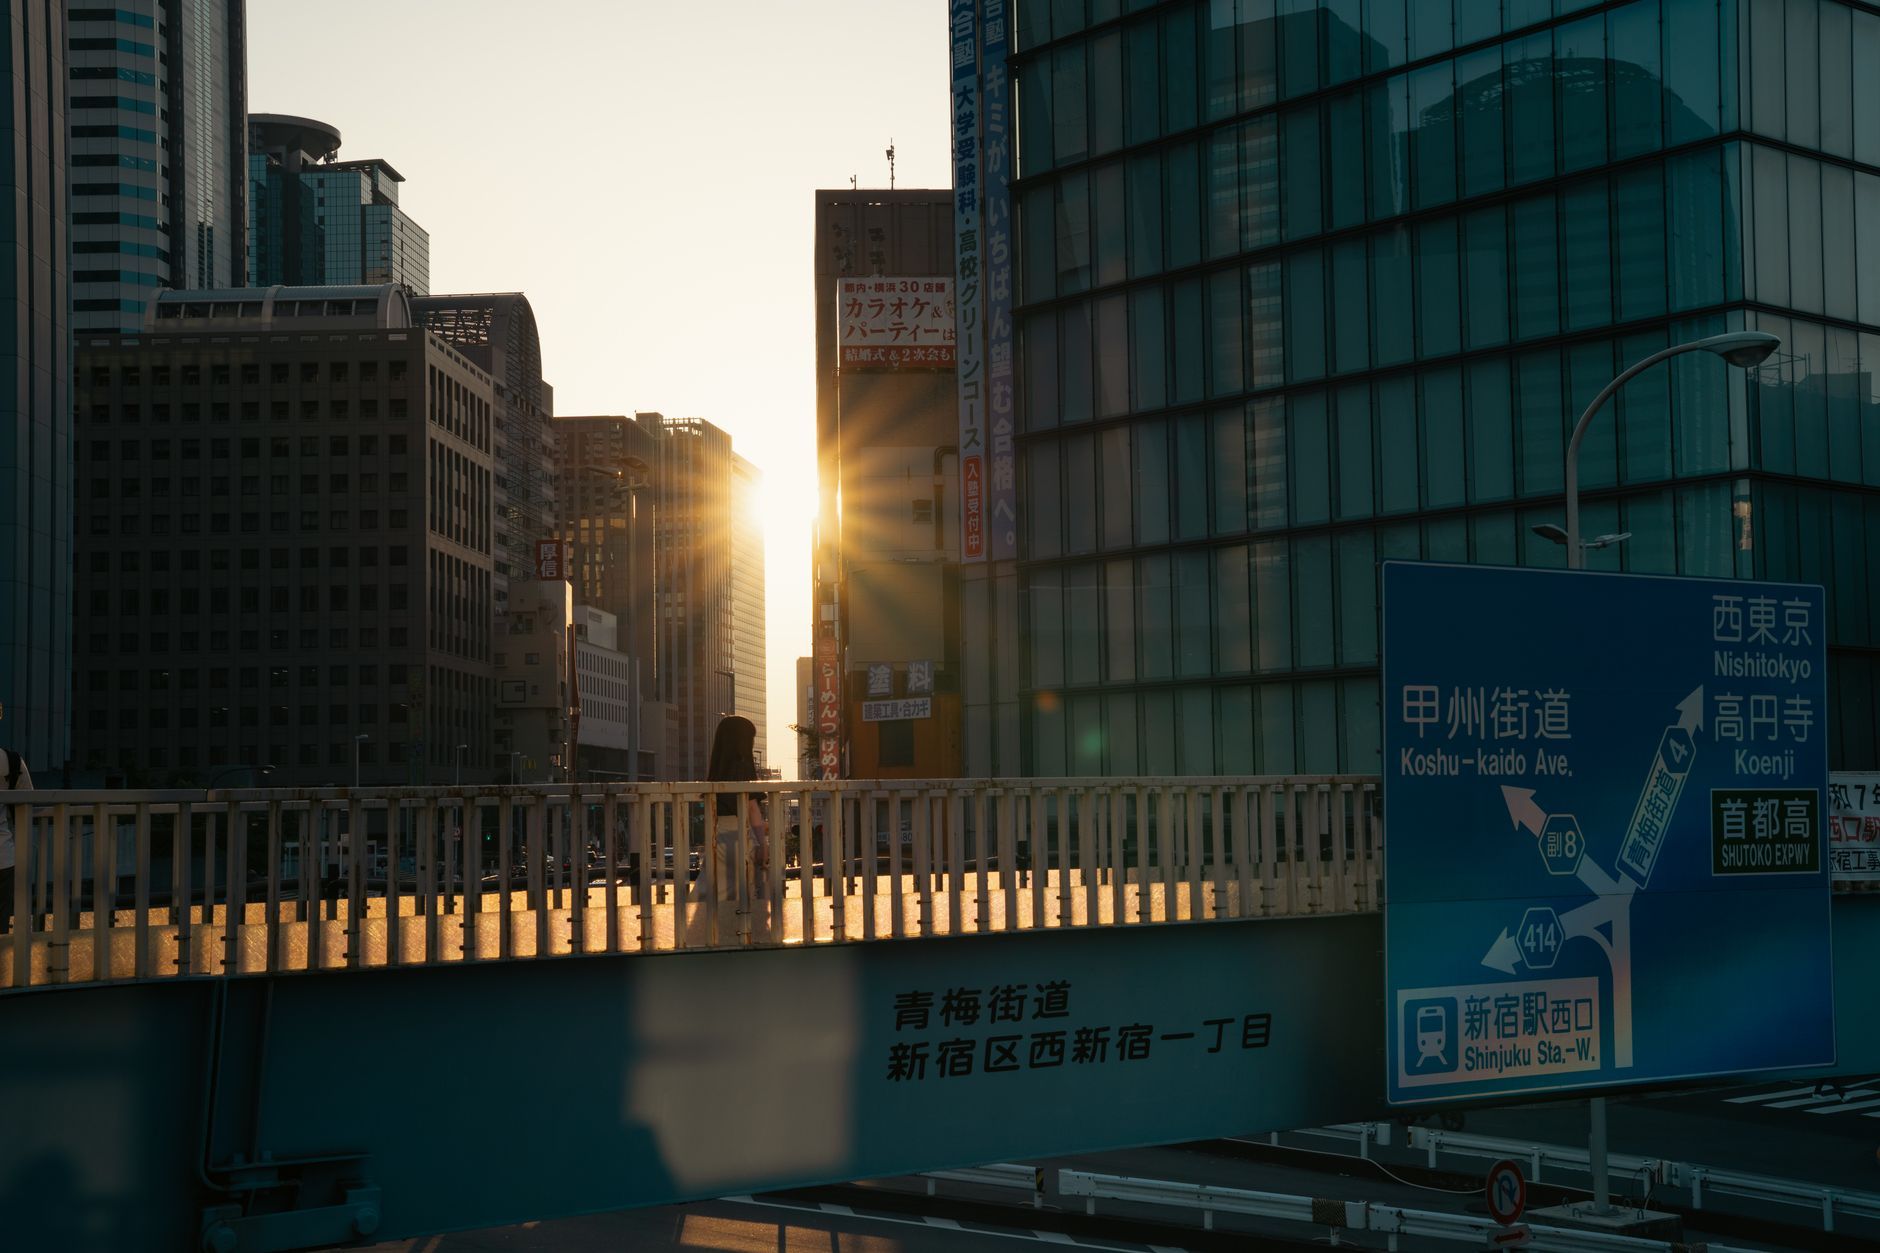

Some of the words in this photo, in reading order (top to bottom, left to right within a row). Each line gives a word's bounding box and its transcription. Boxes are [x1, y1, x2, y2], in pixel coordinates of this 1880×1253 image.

[845, 348, 955, 362] 結婚式&2次会も
[966, 462, 980, 551] 入塾受付中
[1712, 594, 1813, 646] 西東京
[1714, 650, 1811, 684] Nishitokyo
[1402, 684, 1572, 741] 甲州街道
[1713, 691, 1814, 743] 高円寺
[1400, 747, 1527, 777] Koshu-kaido
[1534, 748, 1573, 777] Ave.
[1669, 736, 1689, 763] 4
[1734, 748, 1795, 780] Koenji
[1624, 770, 1678, 872] 青梅街道
[1720, 797, 1811, 840] 首都高
[1722, 844, 1772, 867] SHUTOKO
[1775, 843, 1810, 866] EXPWY
[1523, 922, 1557, 953] 414
[893, 980, 1073, 1031] 青梅街道
[1464, 991, 1594, 1041] 新宿駅西口
[886, 1013, 1273, 1083] 新宿区西新宿一丁目
[1465, 1043, 1532, 1074] Shinjuku
[1537, 1038, 1597, 1065] Sta.-W.
